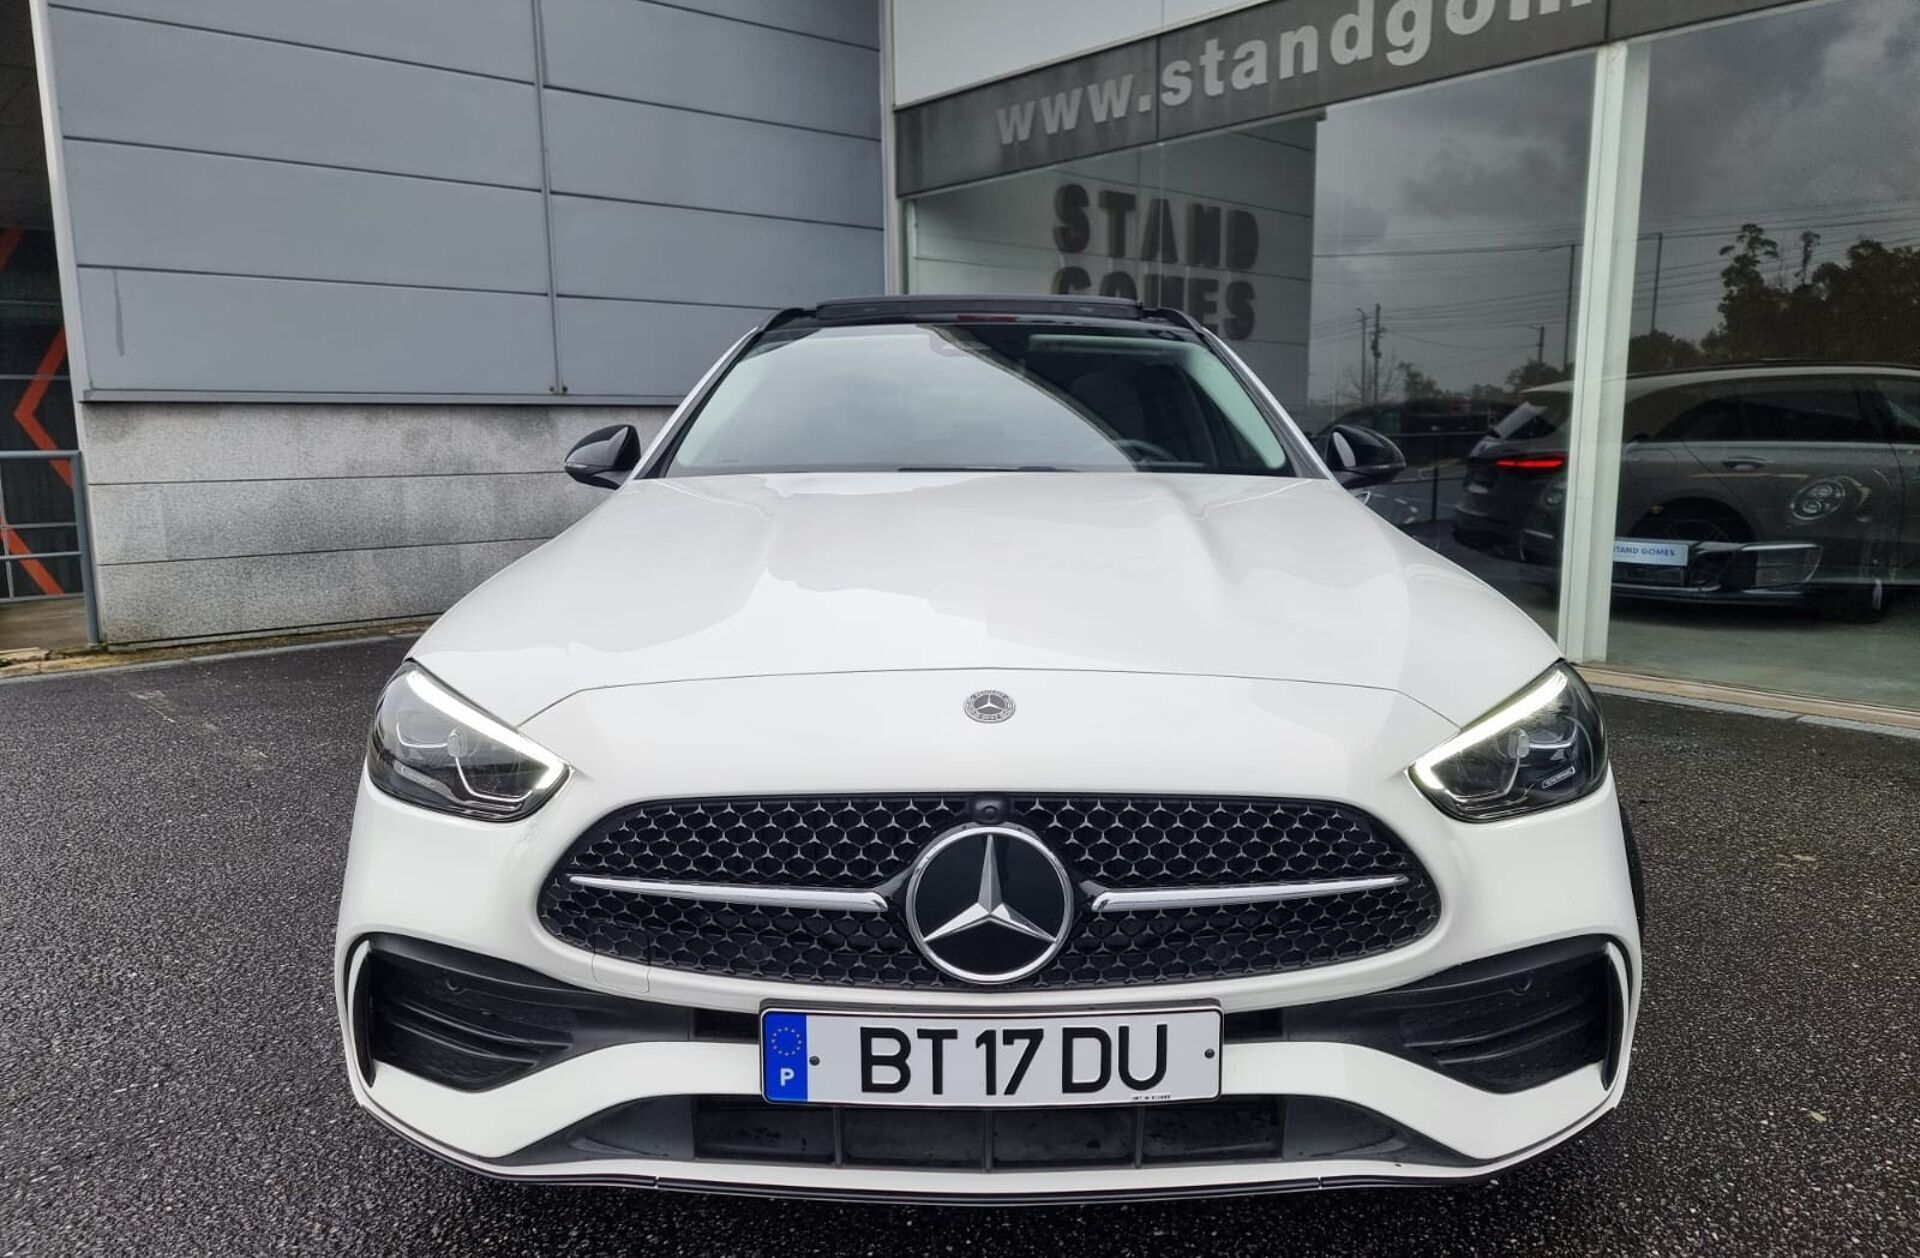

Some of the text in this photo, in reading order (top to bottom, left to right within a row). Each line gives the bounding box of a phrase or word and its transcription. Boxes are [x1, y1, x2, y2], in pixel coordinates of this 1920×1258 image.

[1053, 183, 1259, 270] STAND
[1641, 547, 1675, 557] GOMES
[780, 1067, 795, 1087] P
[860, 1024, 1168, 1096] BT 17 DU
